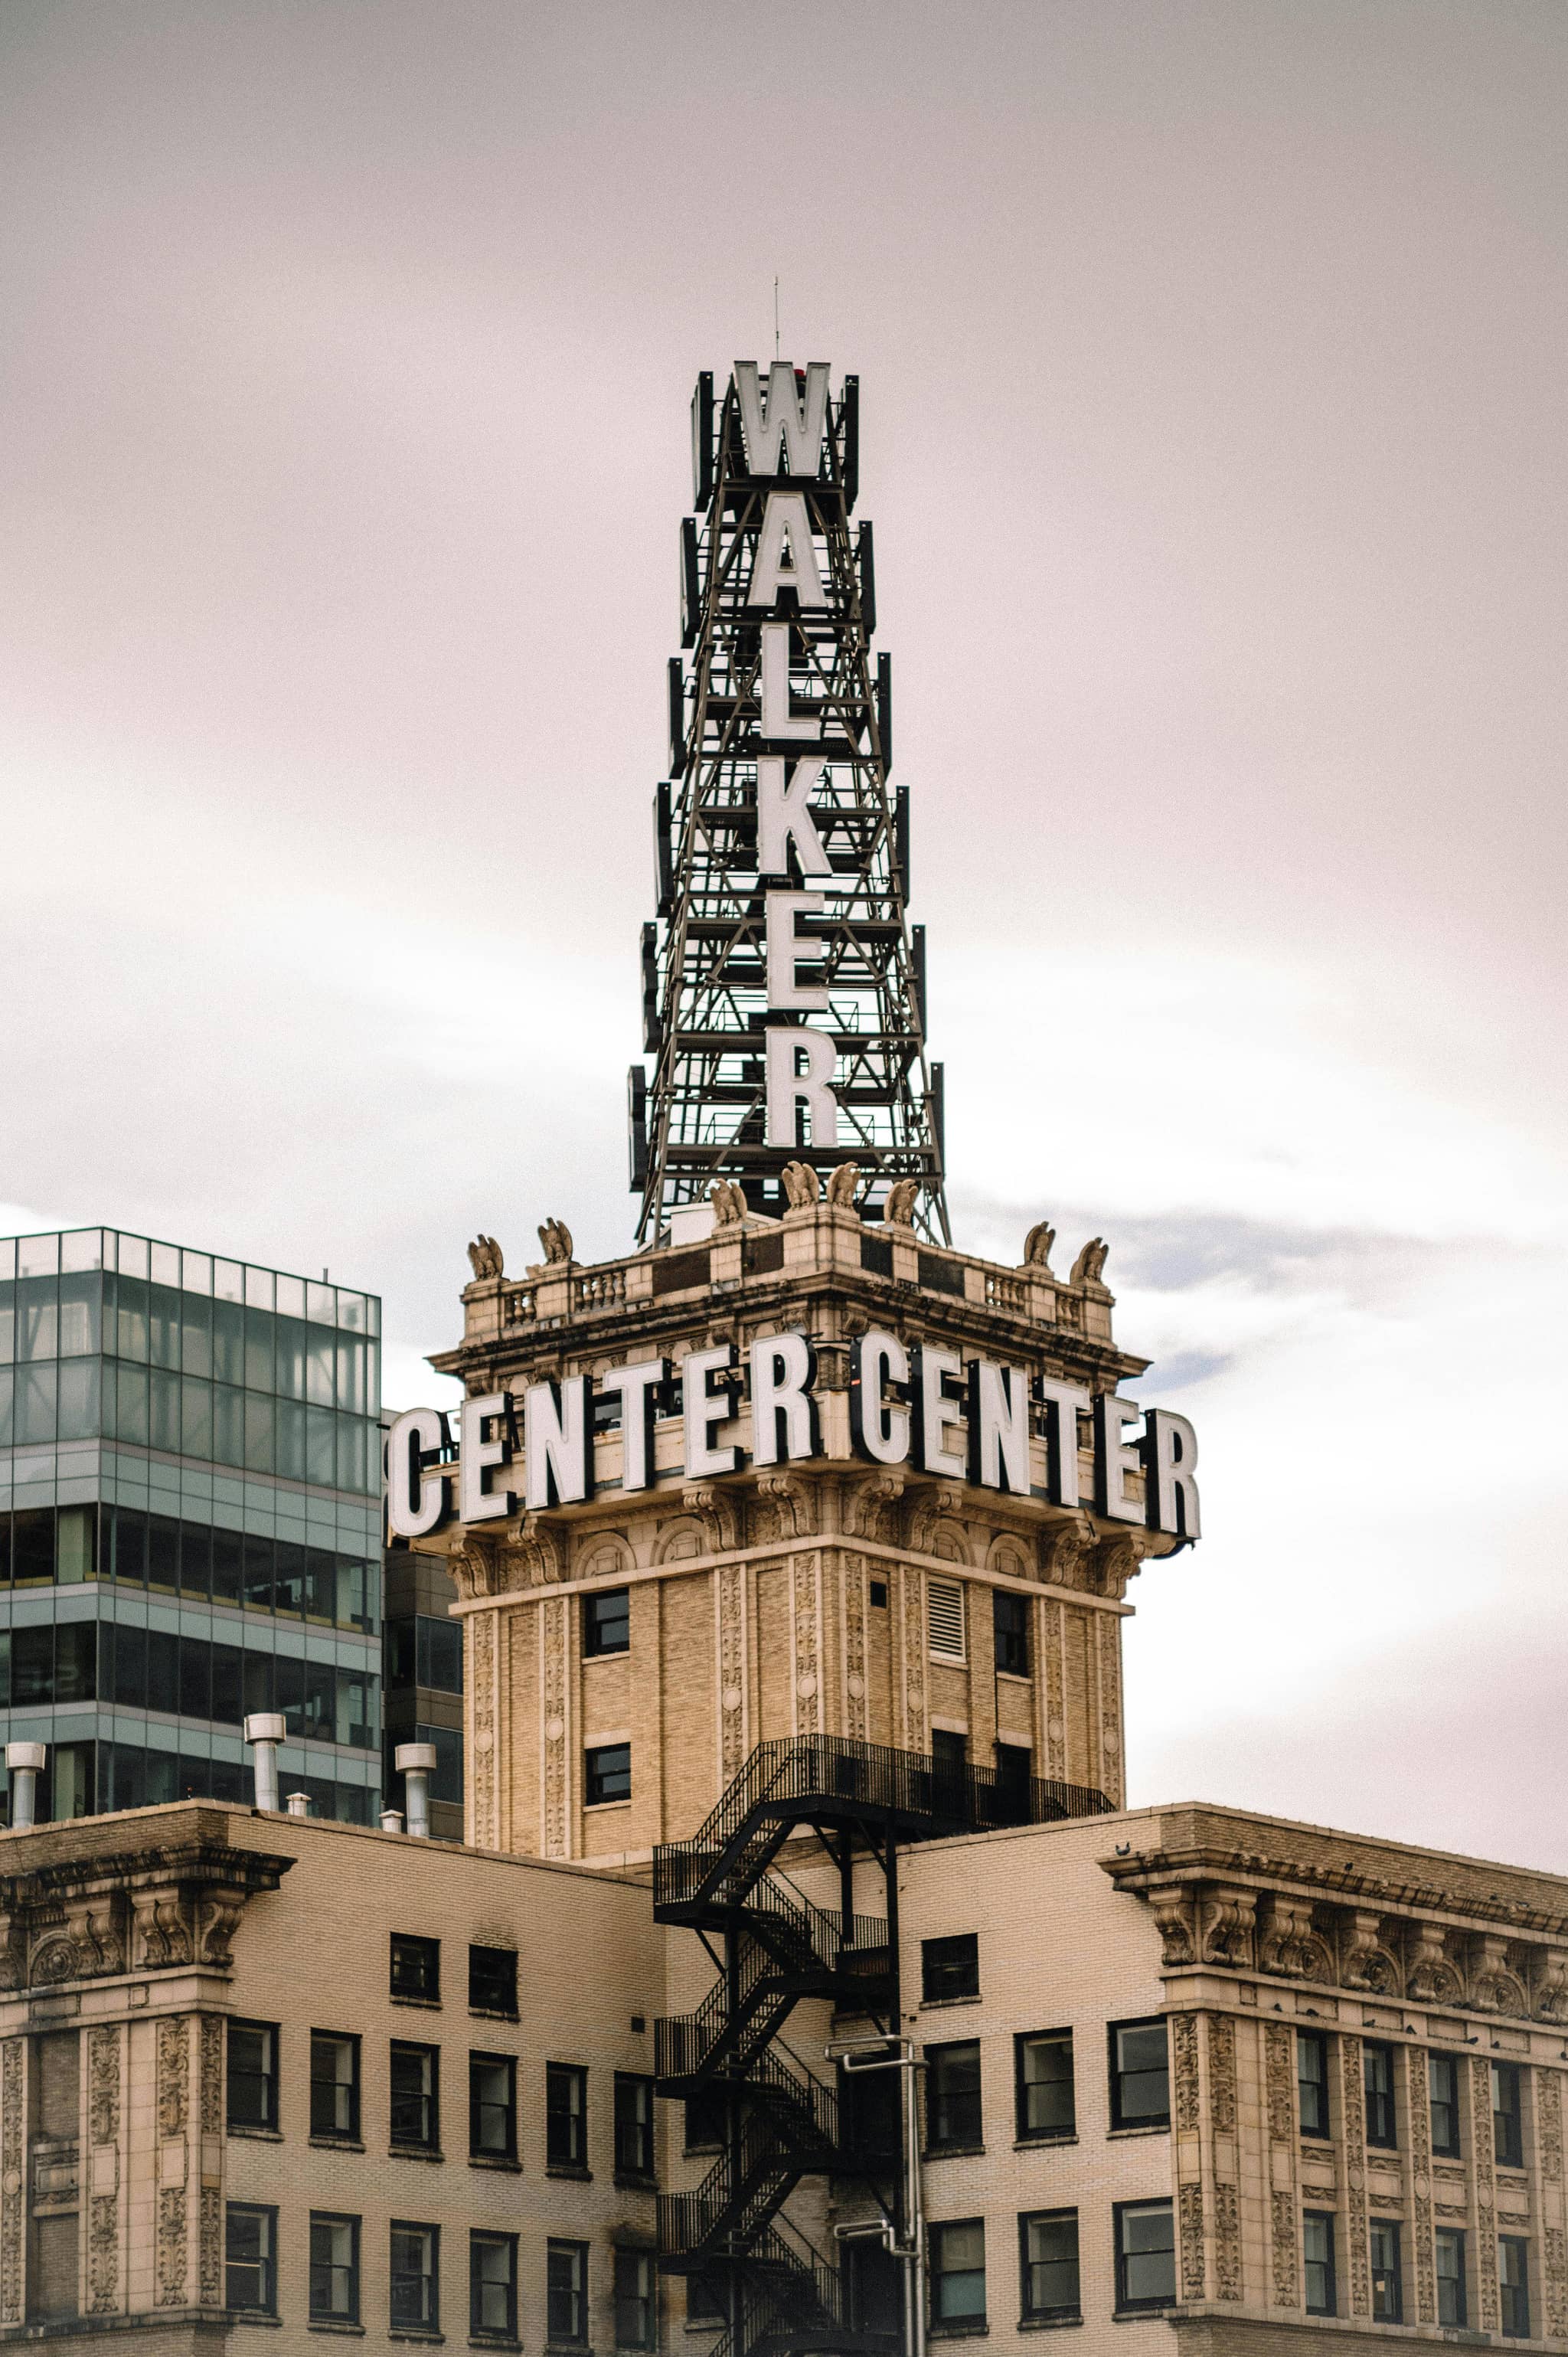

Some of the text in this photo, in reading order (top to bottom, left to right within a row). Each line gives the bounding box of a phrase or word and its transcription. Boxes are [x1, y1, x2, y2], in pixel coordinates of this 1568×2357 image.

[733, 360, 840, 1149] WALKER
[387, 1333, 816, 1538] CENTER
[854, 1329, 1201, 1539] CENTER
